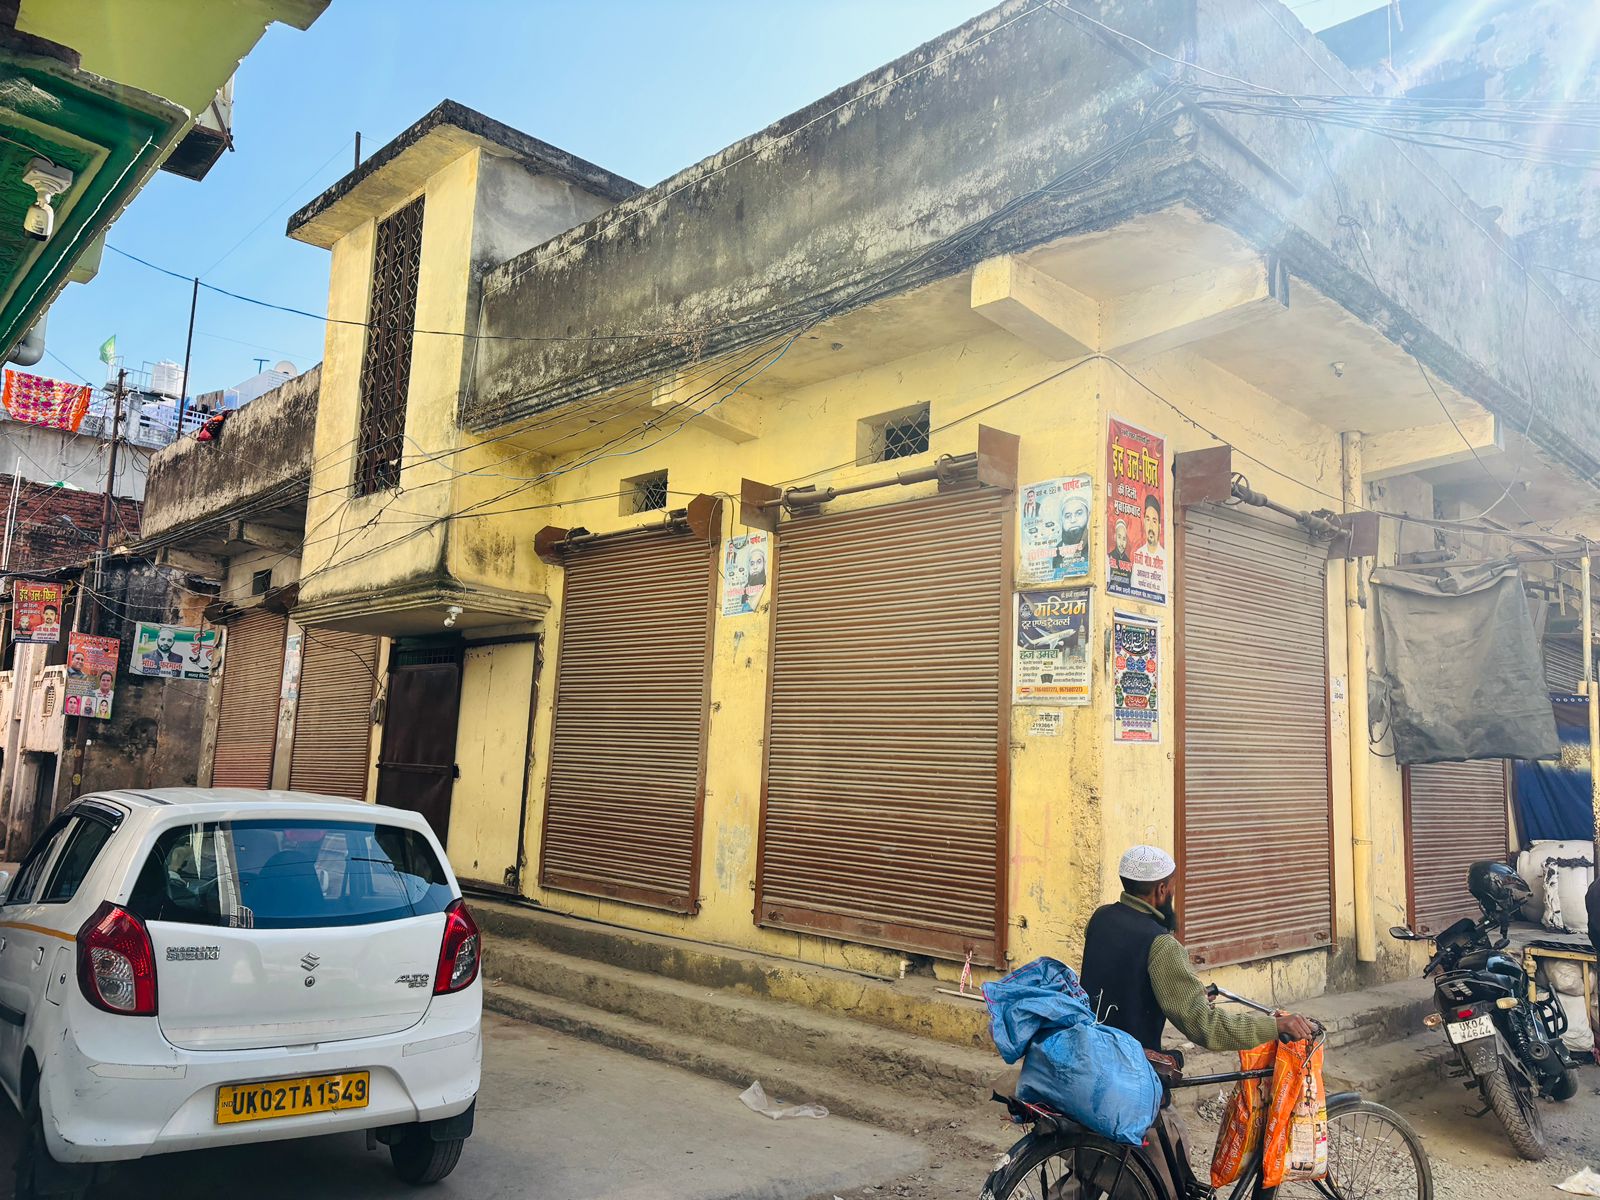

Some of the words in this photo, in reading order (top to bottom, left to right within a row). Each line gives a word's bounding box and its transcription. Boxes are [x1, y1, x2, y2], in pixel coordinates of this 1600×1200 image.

[1034, 596, 1087, 617] मरियम
[1021, 621, 1032, 630] टूर
[1020, 650, 1034, 660] हज
[1036, 650, 1058, 660] उमरा
[166, 951, 220, 961] SUZUKI
[232, 1080, 366, 1115] UK02TA1549
